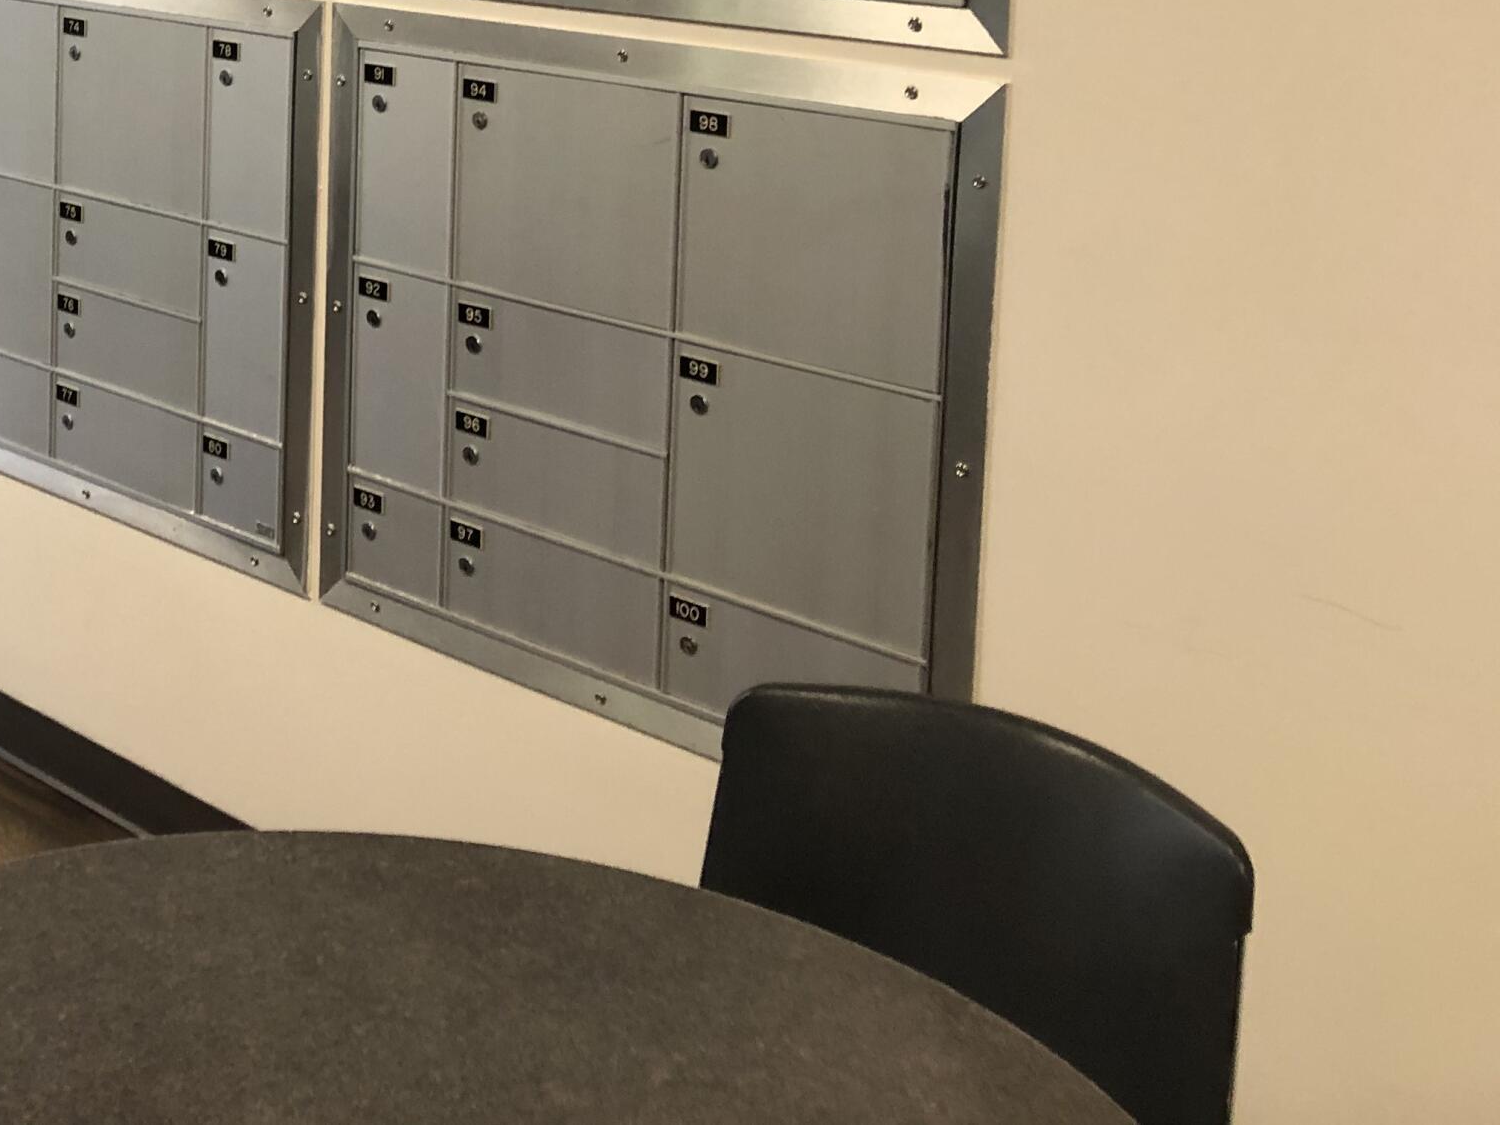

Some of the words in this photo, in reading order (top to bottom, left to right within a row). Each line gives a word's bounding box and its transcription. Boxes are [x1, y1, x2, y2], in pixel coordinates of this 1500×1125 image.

[68, 20, 80, 33] 74
[219, 43, 232, 58] 78
[373, 66, 385, 81] 91
[470, 82, 487, 99] 94
[698, 114, 719, 132] 98
[214, 242, 227, 258] 79
[365, 280, 381, 297] 92
[465, 306, 483, 324] 95
[688, 360, 709, 379] 99
[61, 387, 73, 402] 77
[462, 415, 480, 433] 96
[359, 492, 375, 509] 93
[457, 524, 474, 541] 97
[675, 600, 700, 621] 100
